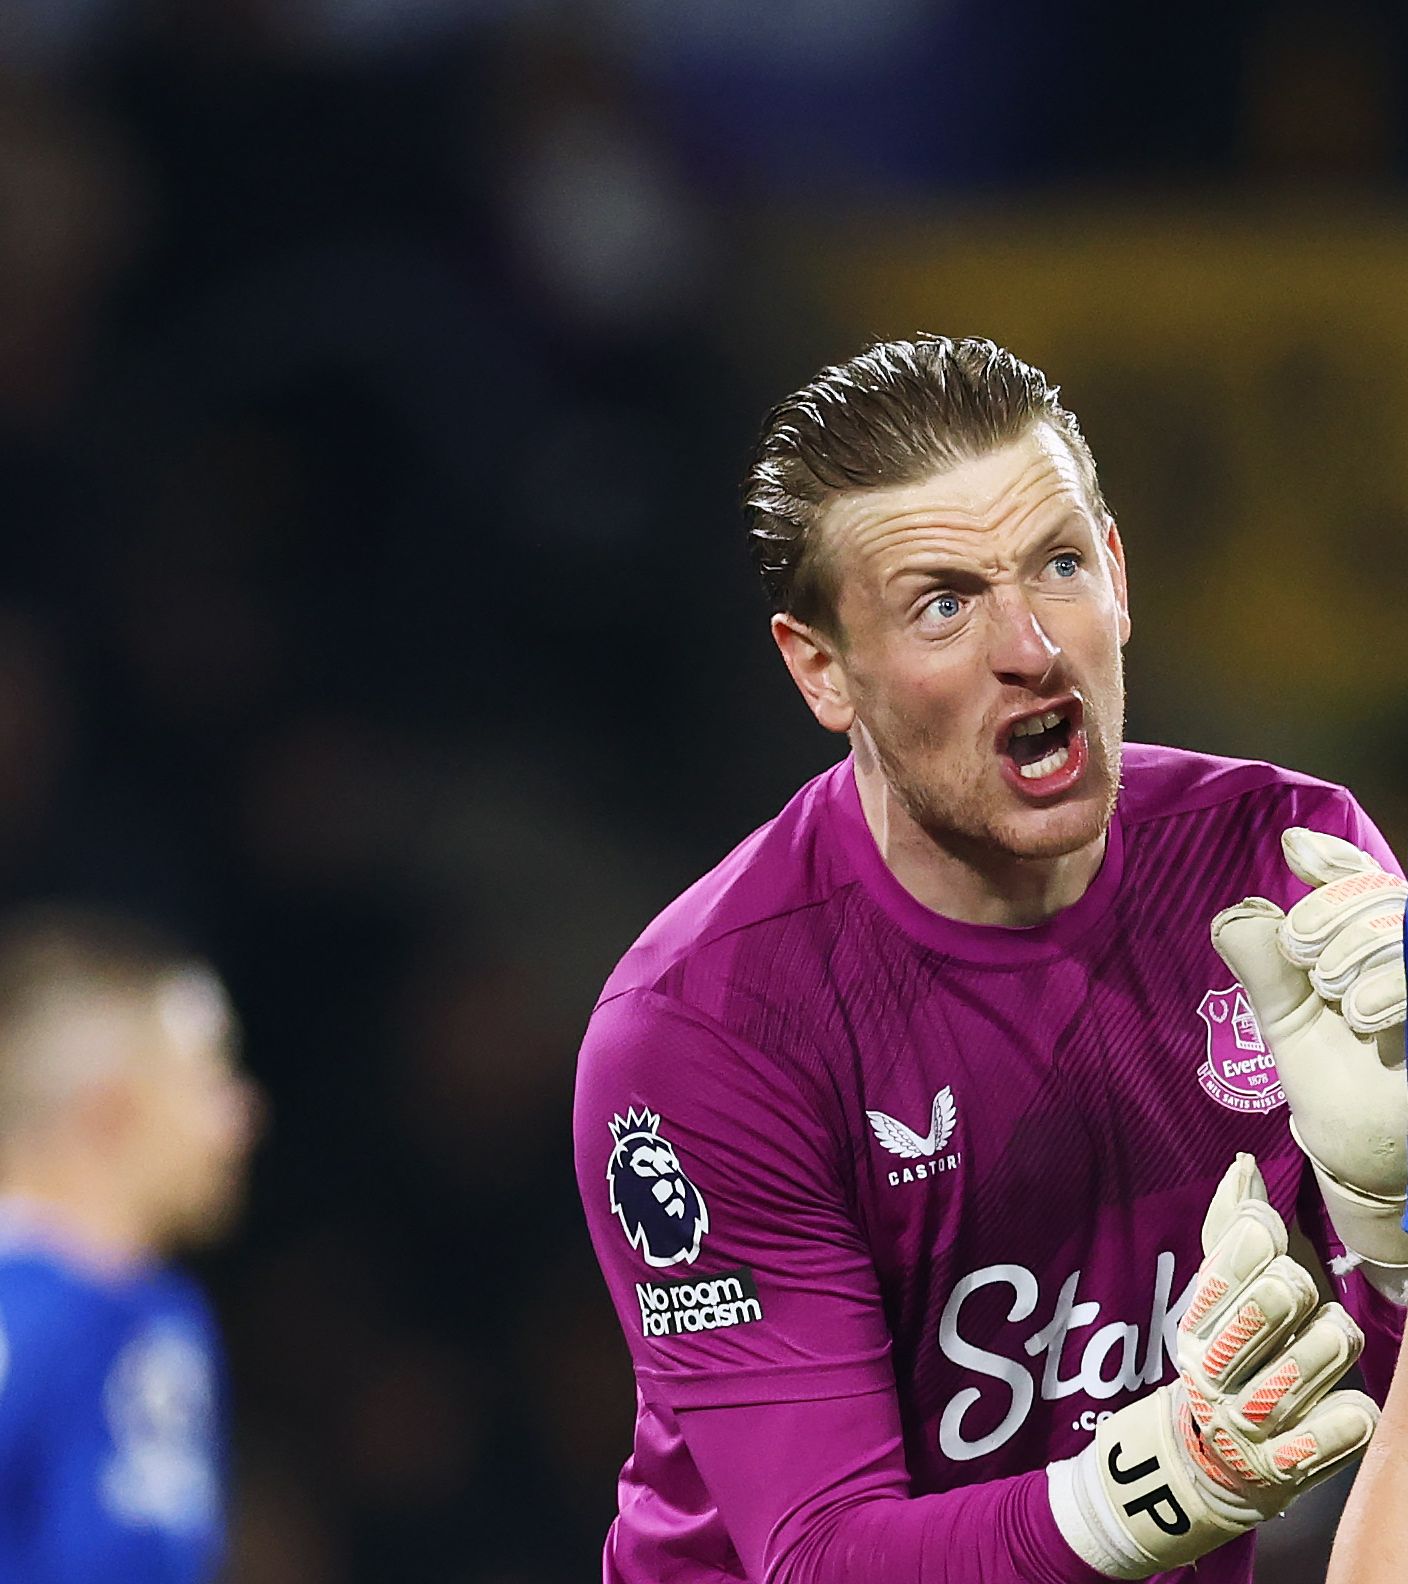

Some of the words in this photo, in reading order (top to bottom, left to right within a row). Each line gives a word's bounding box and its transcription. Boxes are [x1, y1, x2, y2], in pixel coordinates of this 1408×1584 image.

[1222, 1054, 1276, 1078] Everto
[1205, 1080, 1221, 1099] NIL
[1223, 1094, 1251, 1109] SATIS
[1253, 1096, 1276, 1109] NISI
[635, 1282, 669, 1311] No
[669, 1277, 743, 1309] room
[673, 1298, 762, 1333] racism
[939, 1251, 1200, 1461] Stak
[1108, 1440, 1192, 1537] JP
